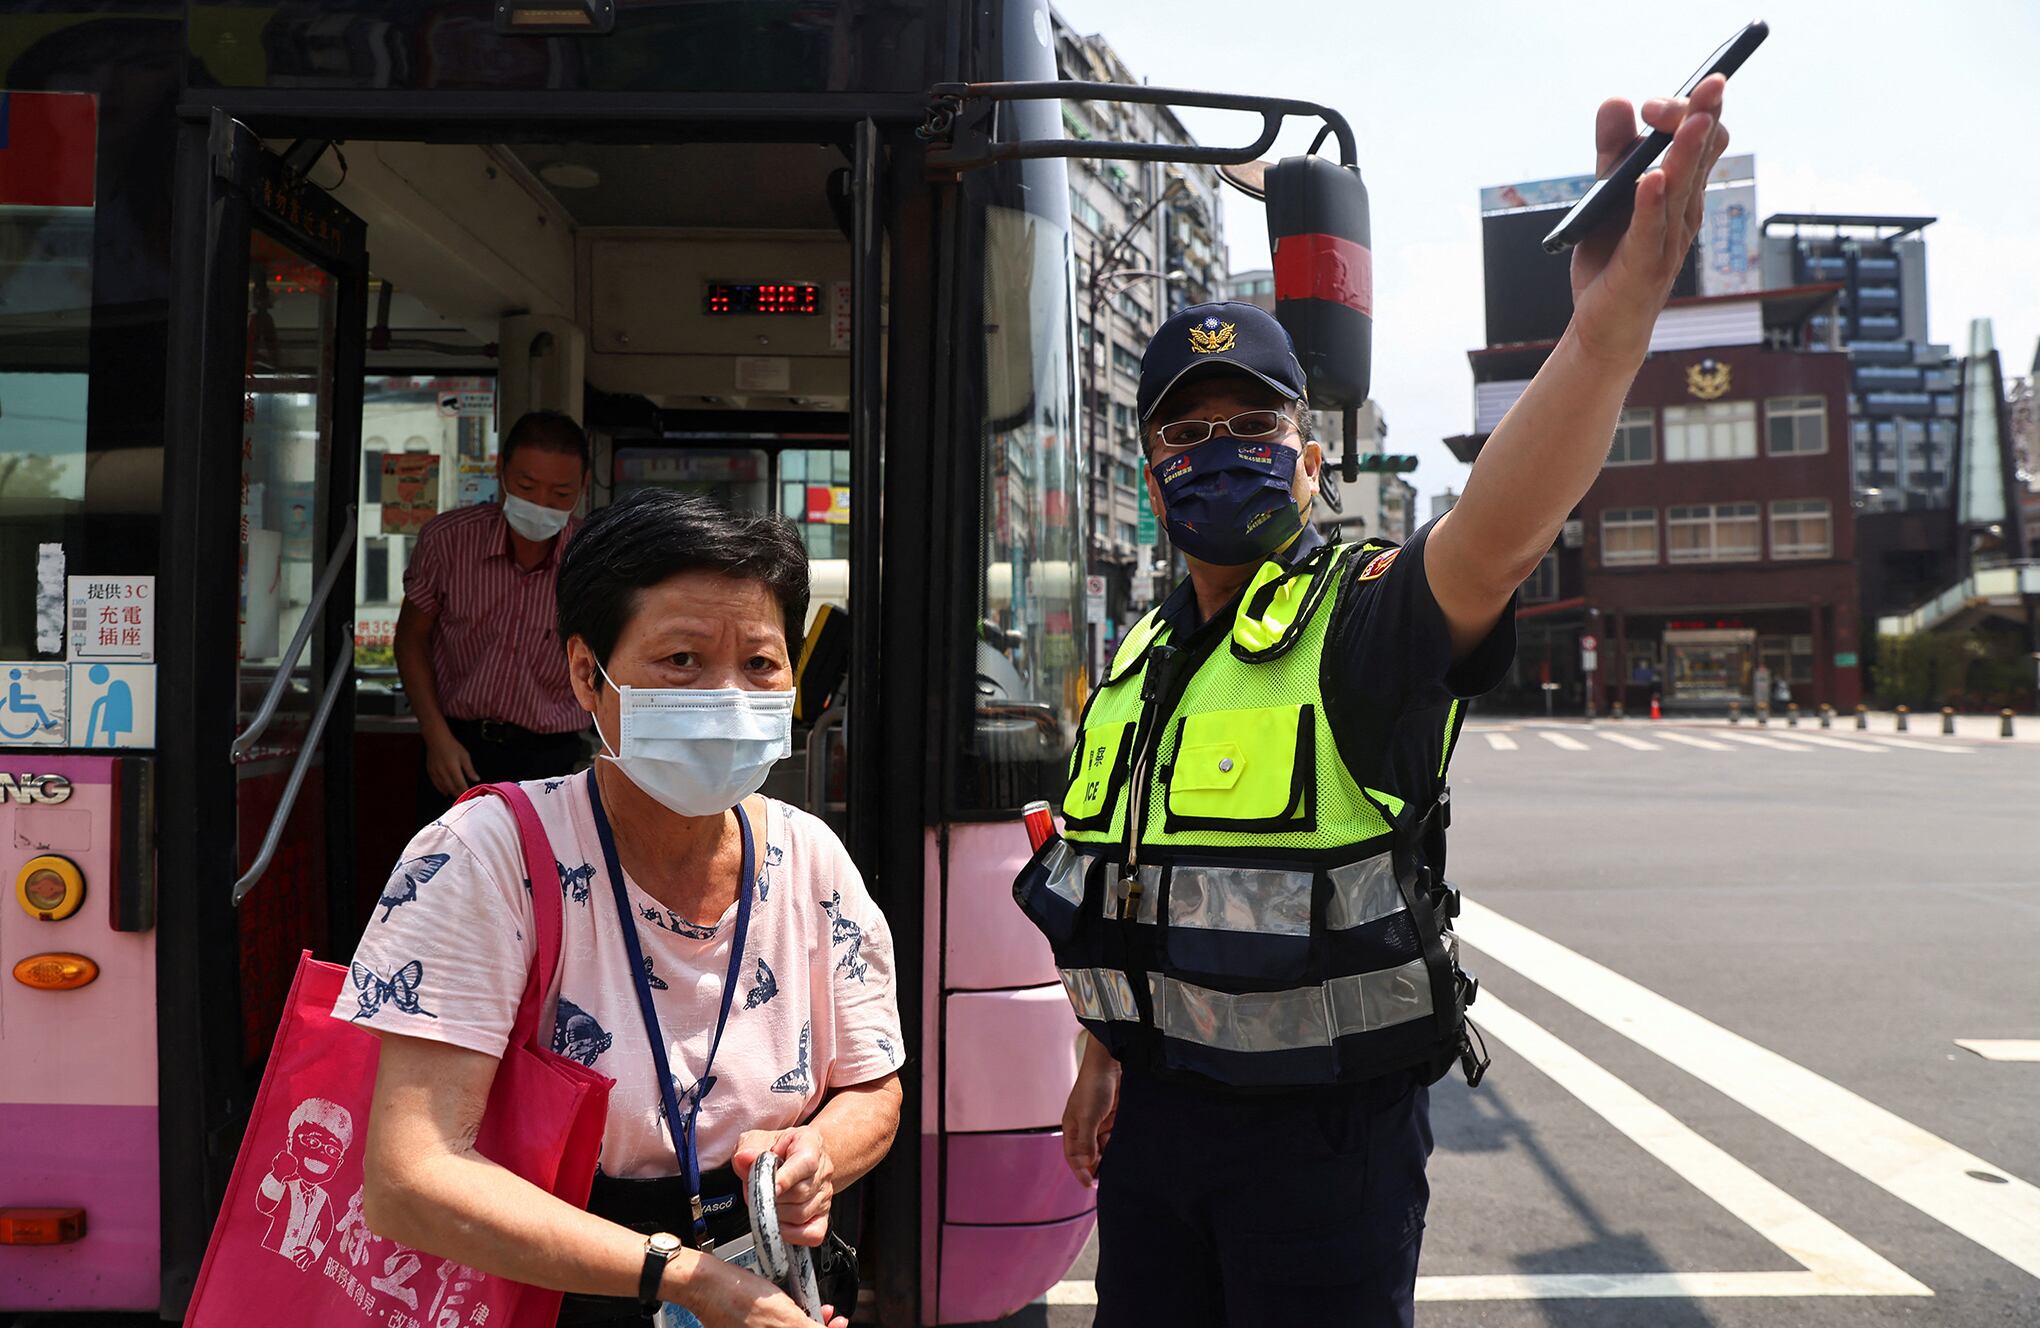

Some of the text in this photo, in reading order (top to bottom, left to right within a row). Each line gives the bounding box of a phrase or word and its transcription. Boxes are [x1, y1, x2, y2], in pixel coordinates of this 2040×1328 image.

[87, 583, 148, 600] 提供3C
[99, 605, 142, 625] 充電
[98, 627, 142, 646] 插座
[0, 772, 71, 805] NG
